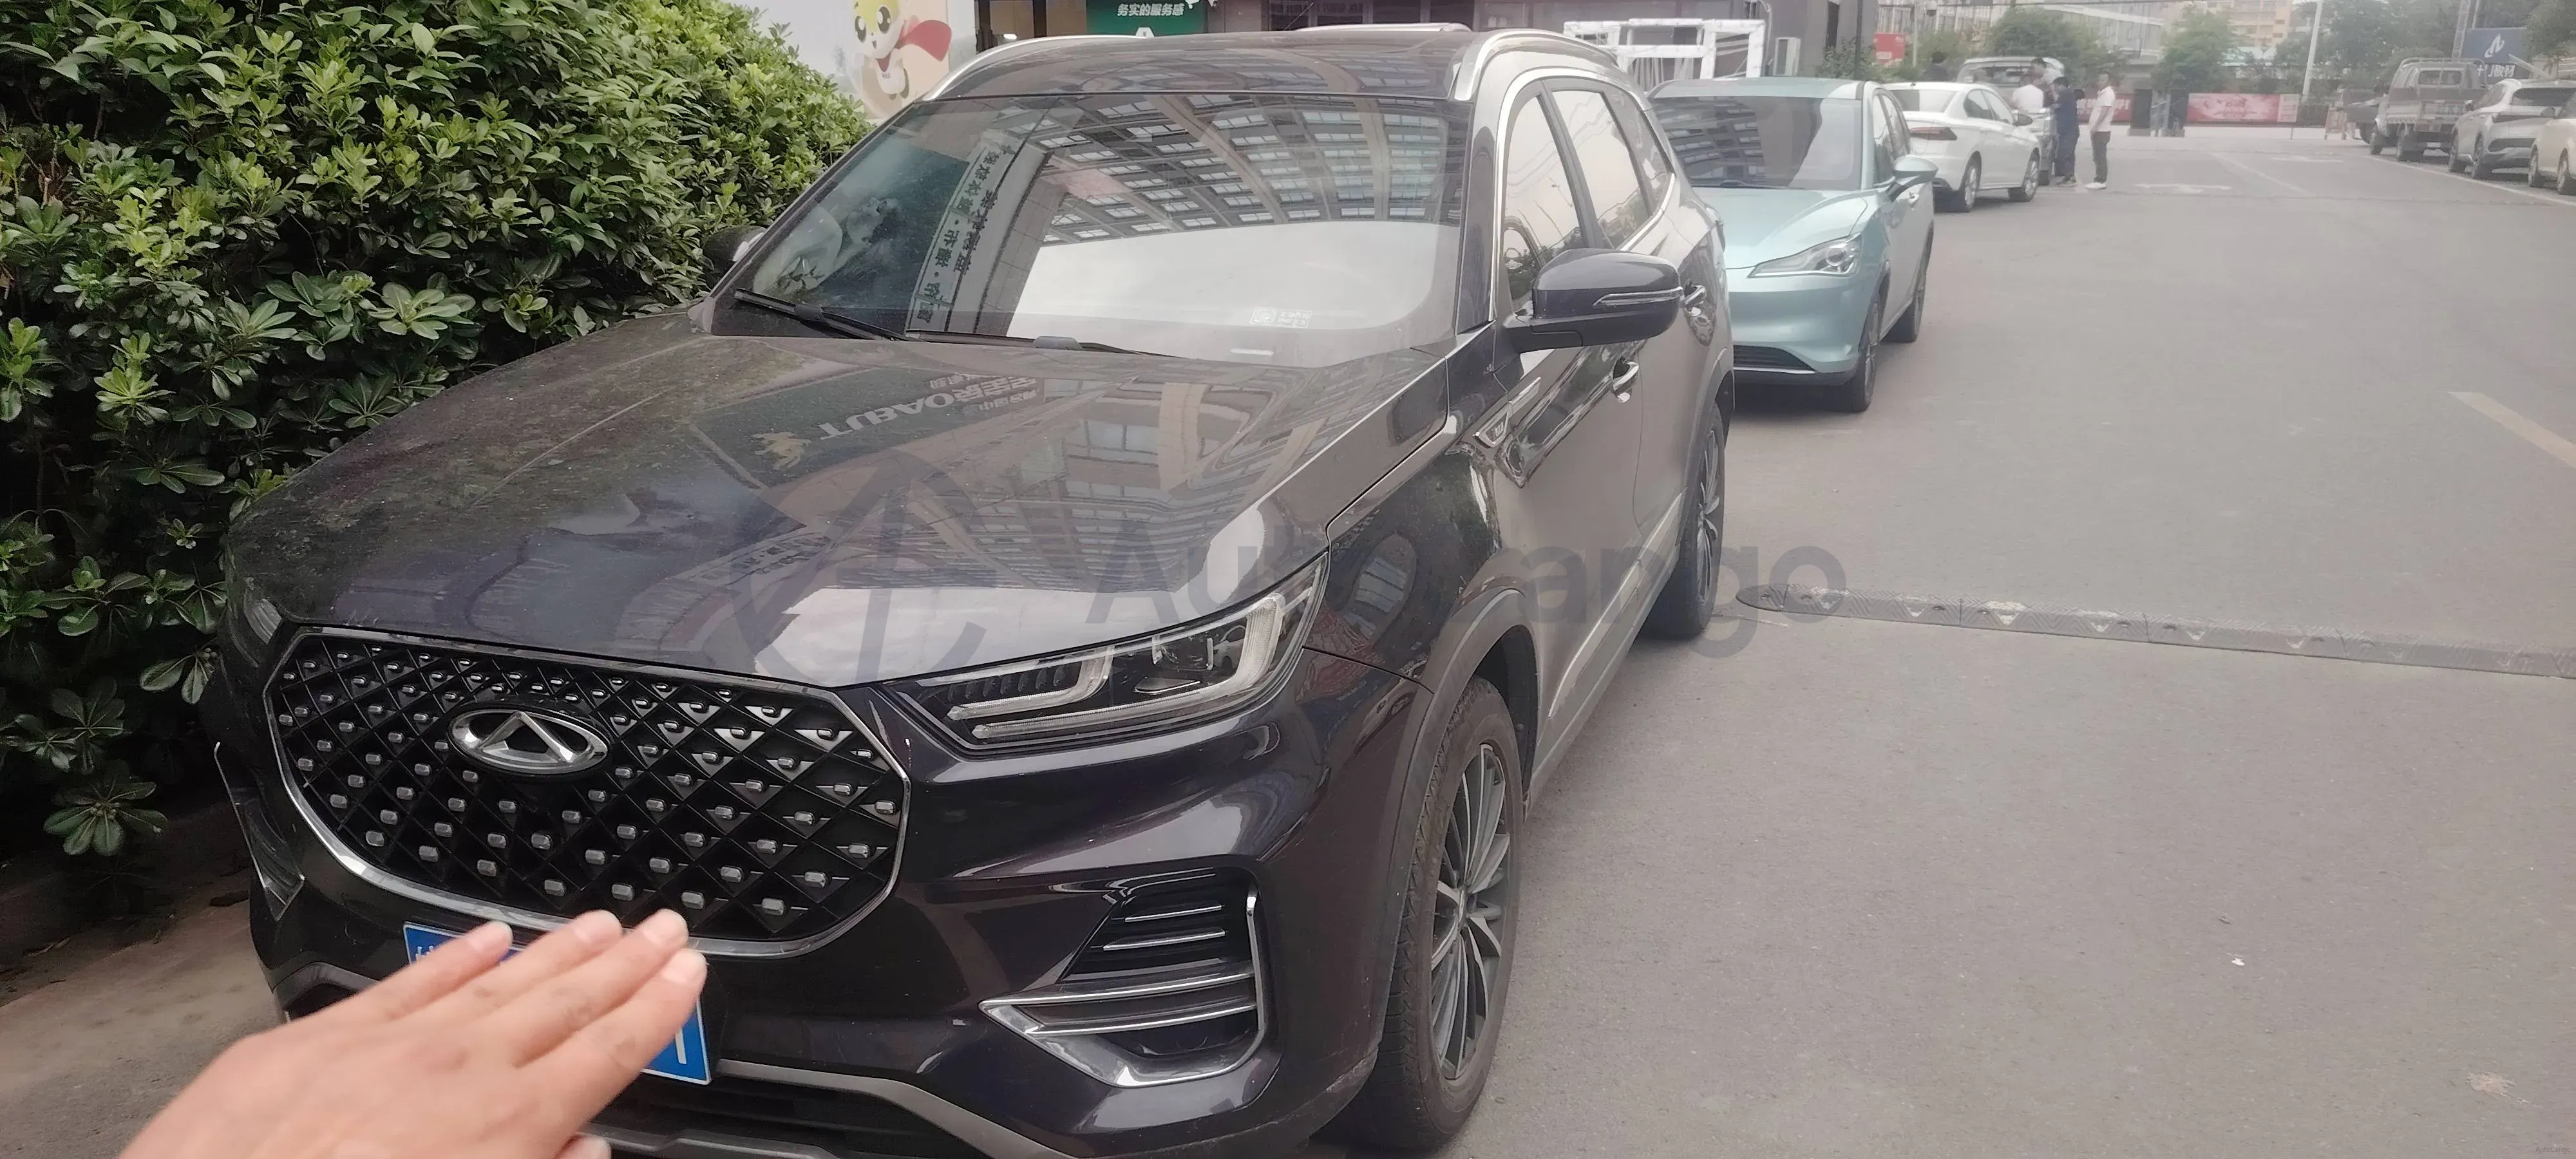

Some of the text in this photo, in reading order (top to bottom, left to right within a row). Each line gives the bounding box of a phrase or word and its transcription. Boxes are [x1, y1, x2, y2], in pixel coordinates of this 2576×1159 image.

[1117, 3, 1185, 17] 务实的服务感
